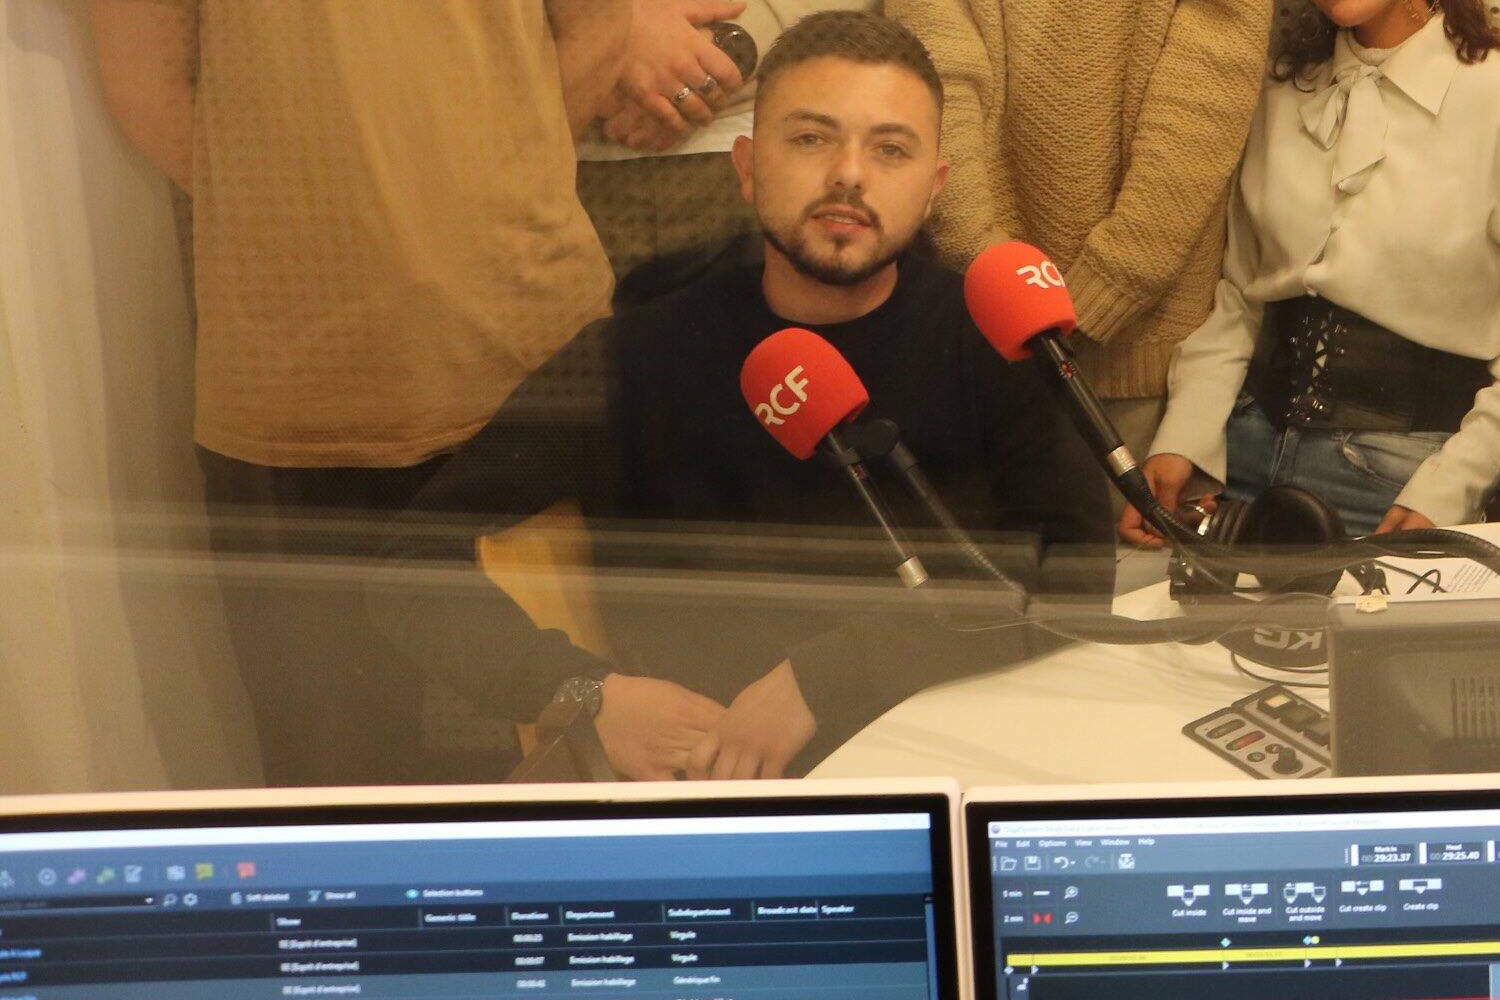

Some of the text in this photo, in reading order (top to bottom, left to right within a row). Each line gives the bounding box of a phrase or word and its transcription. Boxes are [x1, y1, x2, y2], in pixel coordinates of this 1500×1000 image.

[1014, 259, 1068, 290] RC
[754, 364, 810, 427] RCF
[1038, 838, 1067, 849] Options
[1074, 838, 1092, 847] View
[1100, 837, 1131, 847] Window
[1138, 837, 1155, 846] Help
